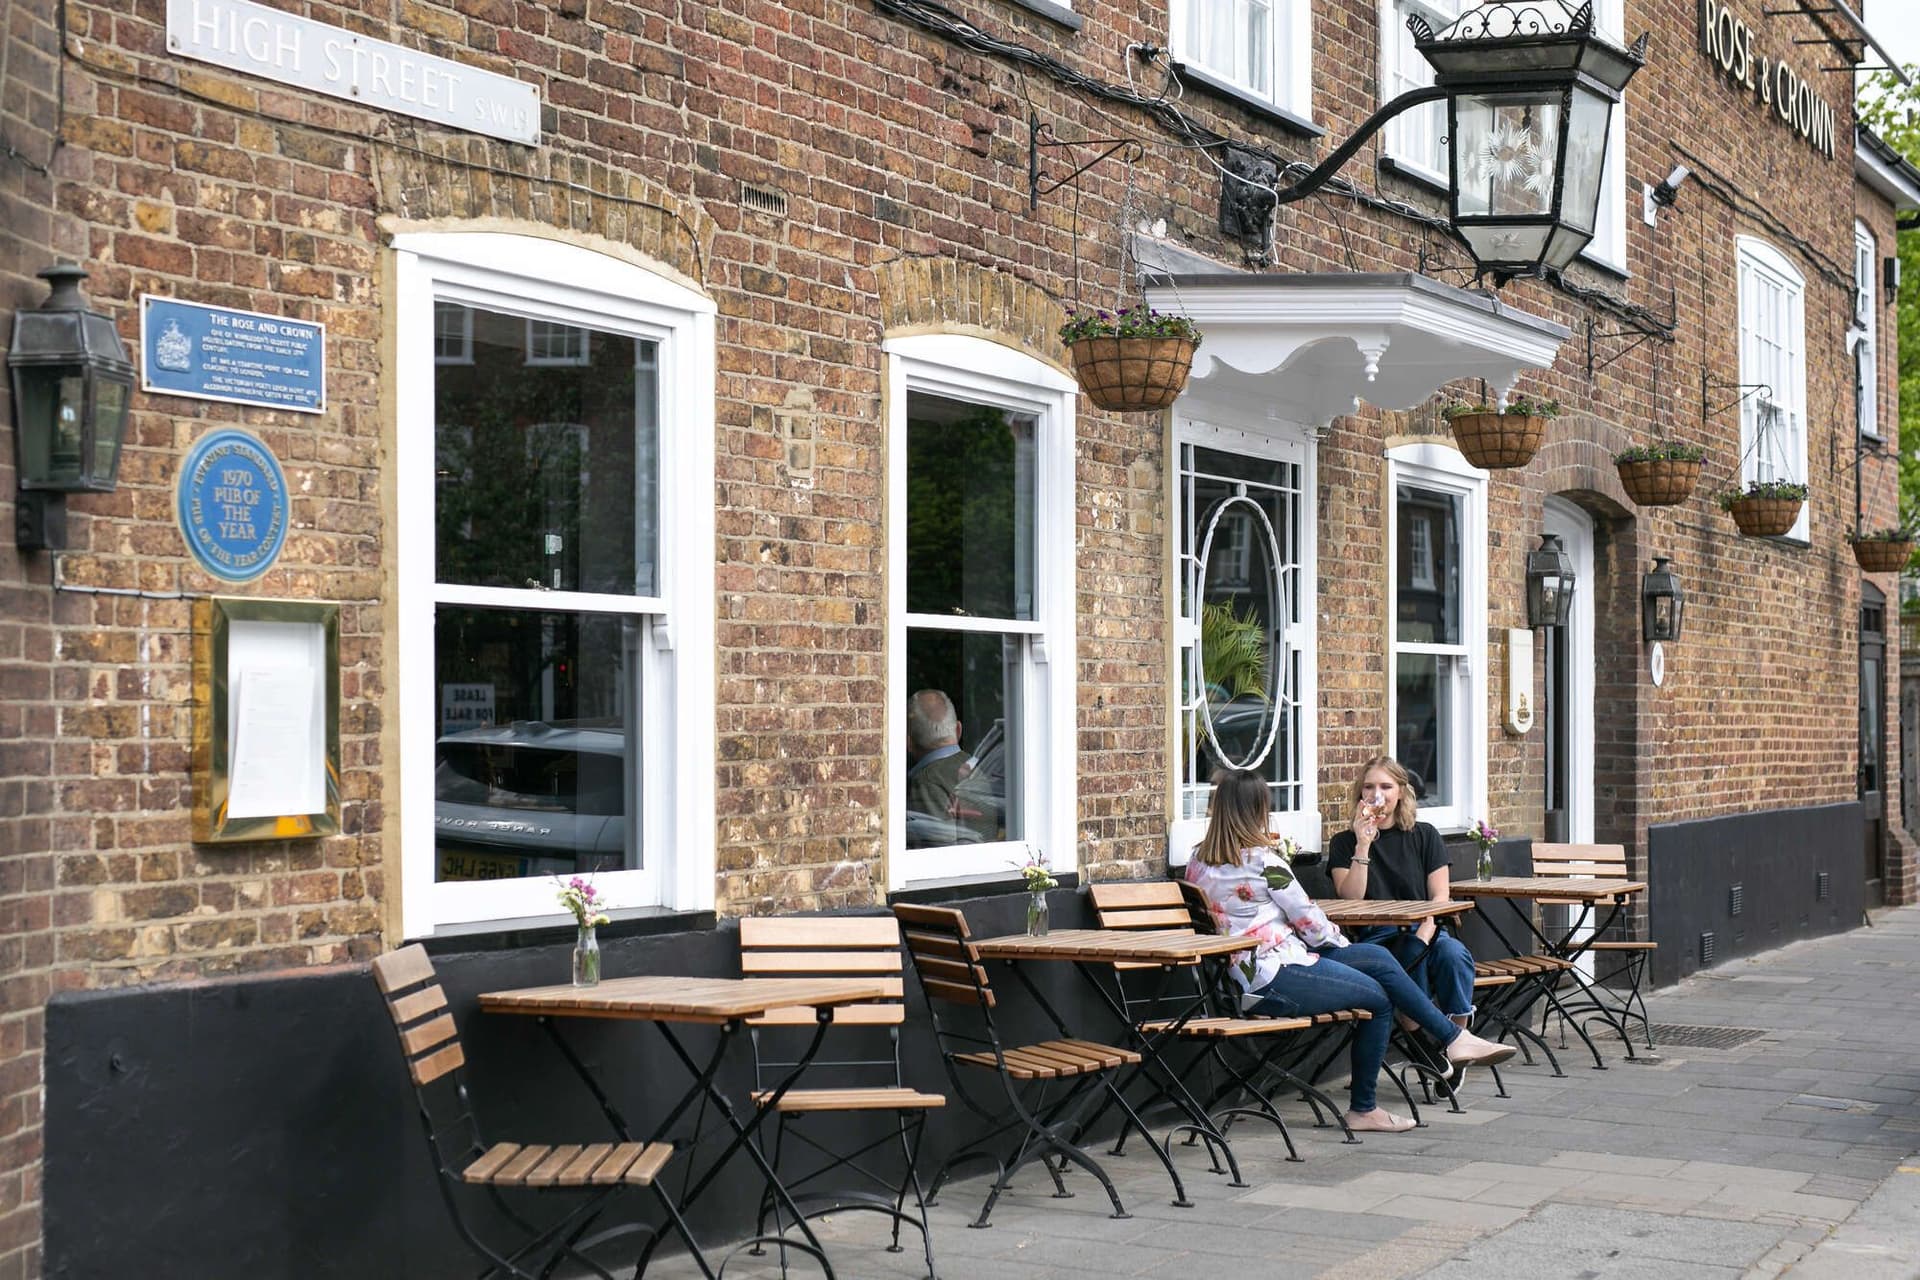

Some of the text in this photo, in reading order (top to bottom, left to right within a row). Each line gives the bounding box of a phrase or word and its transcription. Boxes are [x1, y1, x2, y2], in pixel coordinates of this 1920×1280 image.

[192, 0, 301, 72] HIGH
[323, 39, 462, 113] STREET
[1705, 0, 1835, 160] ROSE & CROWN
[210, 314, 313, 339] THE ROSE AND CROWN
[222, 469, 253, 487] 1970
[214, 487, 261, 505] PUB OF
[222, 504, 252, 522] THE
[191, 498, 203, 525] PUB
[211, 543, 232, 565] THE
[233, 551, 259, 567] YEAR
[218, 522, 257, 540] YEAR
